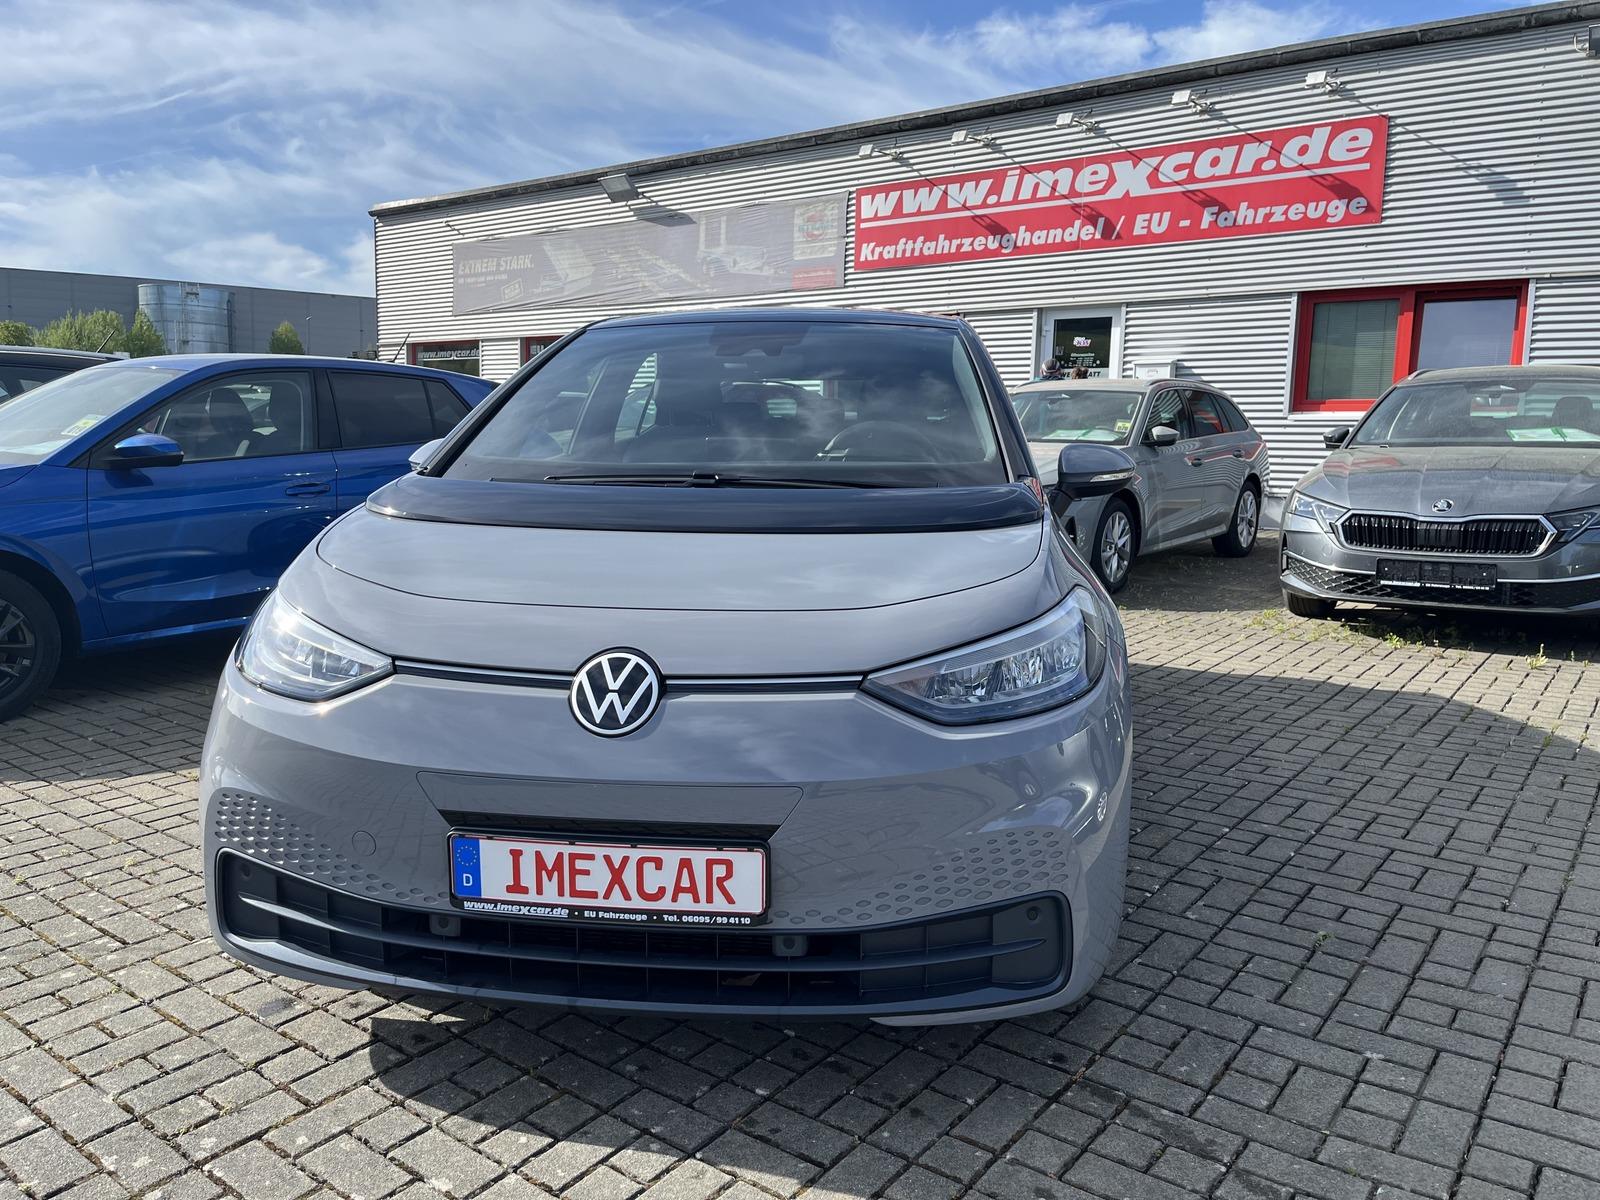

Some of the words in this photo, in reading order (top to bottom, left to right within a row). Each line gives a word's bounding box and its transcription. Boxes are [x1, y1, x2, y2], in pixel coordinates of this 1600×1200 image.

[860, 126, 1374, 219] www.imexcar.de
[860, 217, 1105, 261] Kraftfahrzeughandel
[1132, 211, 1171, 236] EU
[1200, 197, 1367, 229] Fahrzeuge
[462, 873, 473, 887] D
[505, 848, 735, 904] IMEXCAR
[463, 901, 569, 918] www.imexcar.de
[584, 910, 597, 918] EU
[598, 911, 648, 921] Fahrzeuge
[663, 914, 680, 922] Tel.
